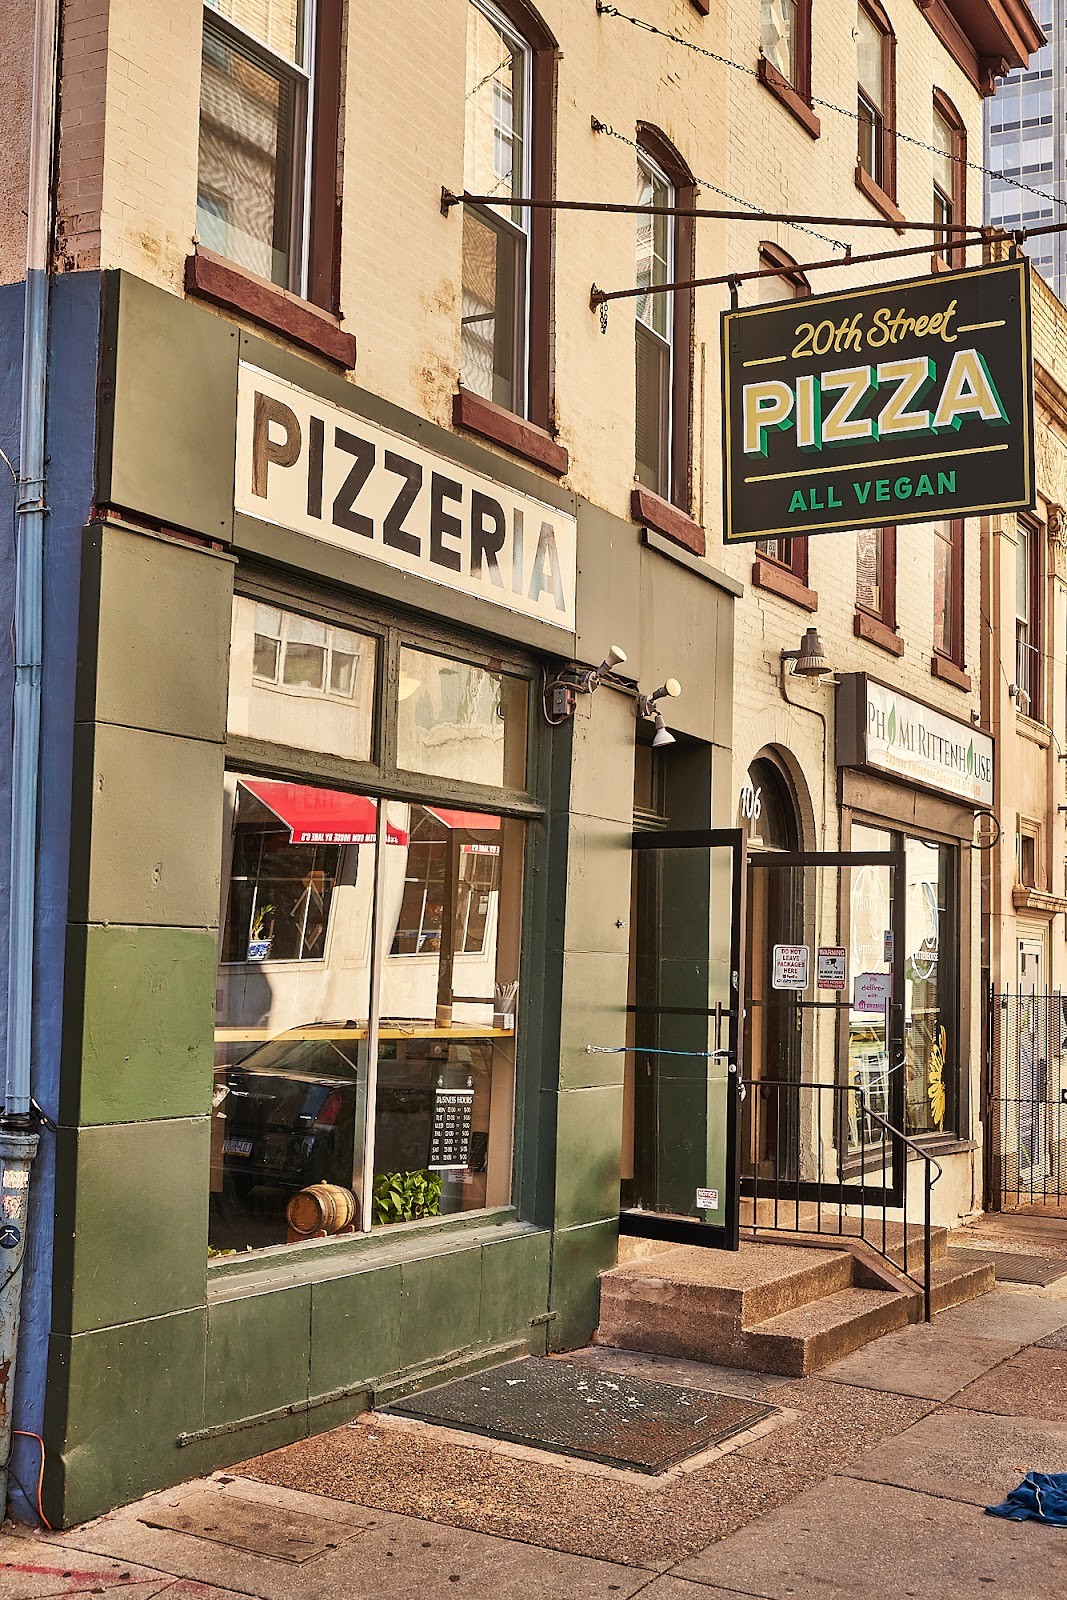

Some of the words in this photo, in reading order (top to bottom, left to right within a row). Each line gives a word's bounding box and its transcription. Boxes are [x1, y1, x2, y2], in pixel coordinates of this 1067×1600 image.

[791, 312, 863, 359] 20th
[865, 299, 958, 348] Street
[742, 348, 1011, 459] PIZZA
[251, 389, 567, 613] PIZZERIA
[787, 485, 843, 513] ALL
[852, 470, 956, 505] VEGAN
[741, 787, 762, 820] 106
[861, 983, 885, 992] deliver
[436, 1096, 456, 1104] BUSINESS
[457, 1096, 473, 1104] HOURS
